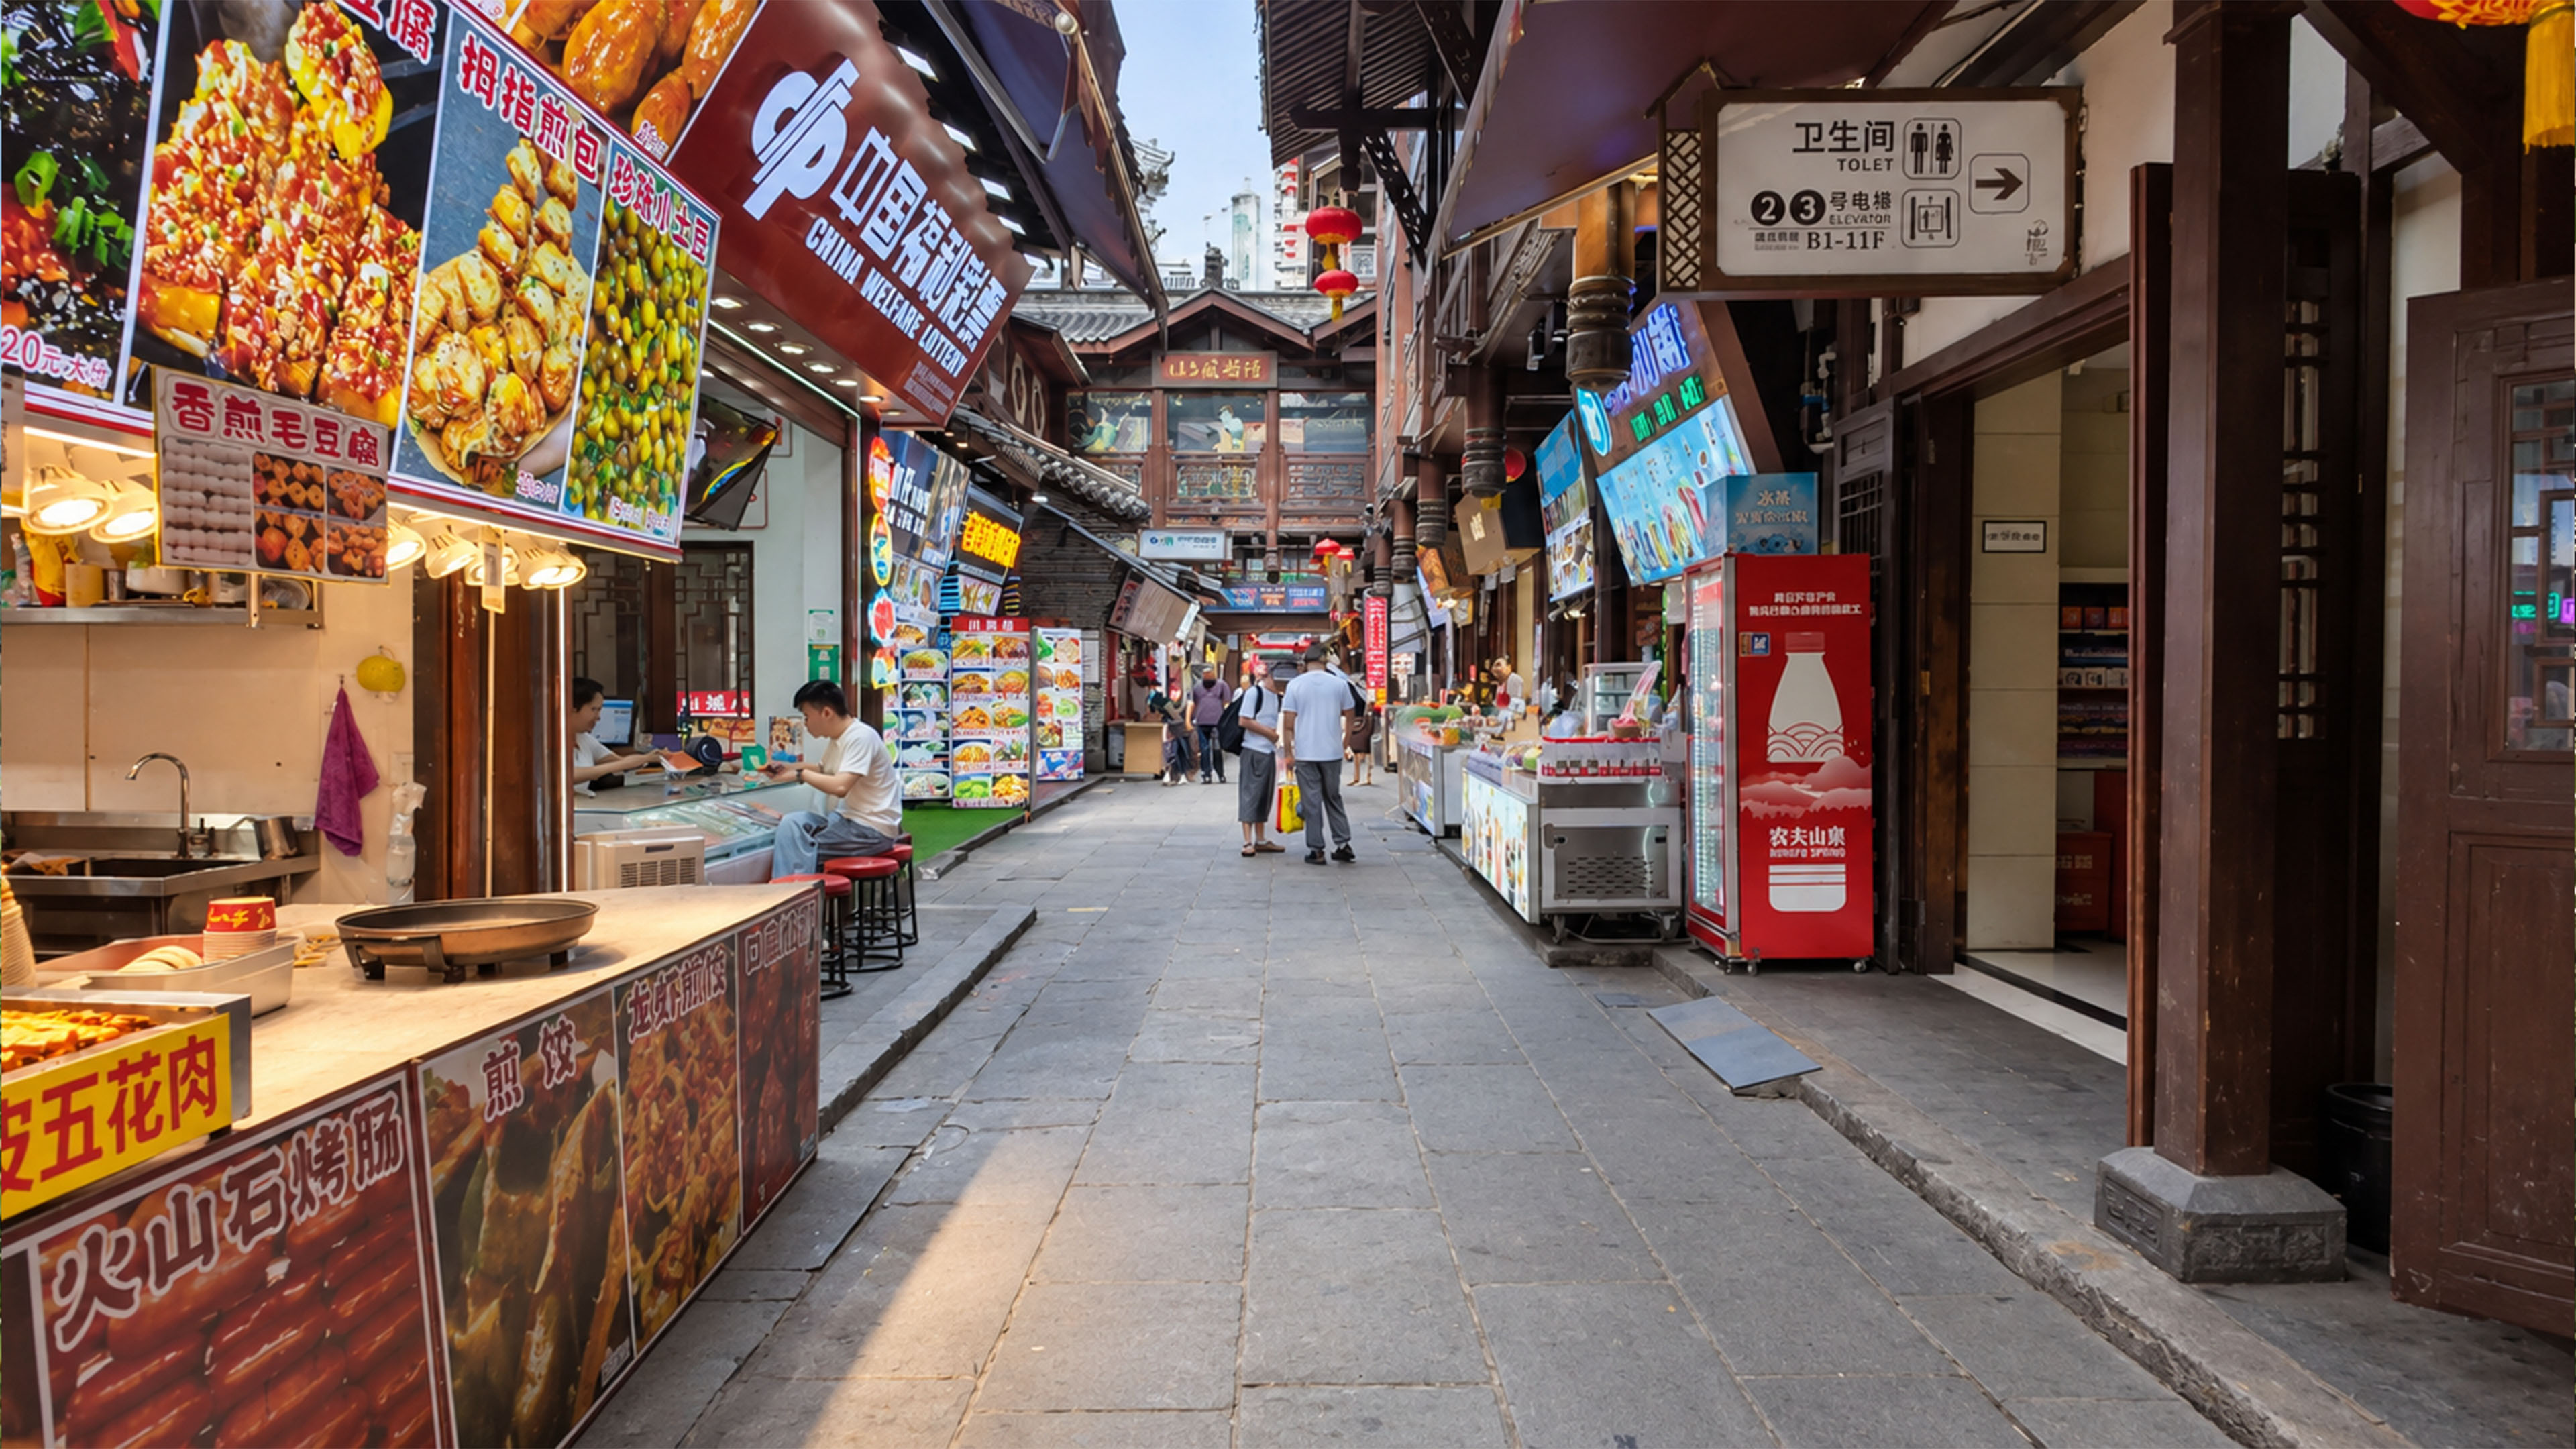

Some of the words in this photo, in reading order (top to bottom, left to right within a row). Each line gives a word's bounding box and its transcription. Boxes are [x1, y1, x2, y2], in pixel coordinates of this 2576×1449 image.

[458, 30, 604, 186] 拇指煎包
[1792, 119, 1895, 153] 卫生间
[1837, 158, 1894, 172] TOLET
[806, 216, 865, 285] CHINA
[1807, 231, 1885, 250] B1-11F
[52, 1091, 405, 1352] 火山石烤肠
